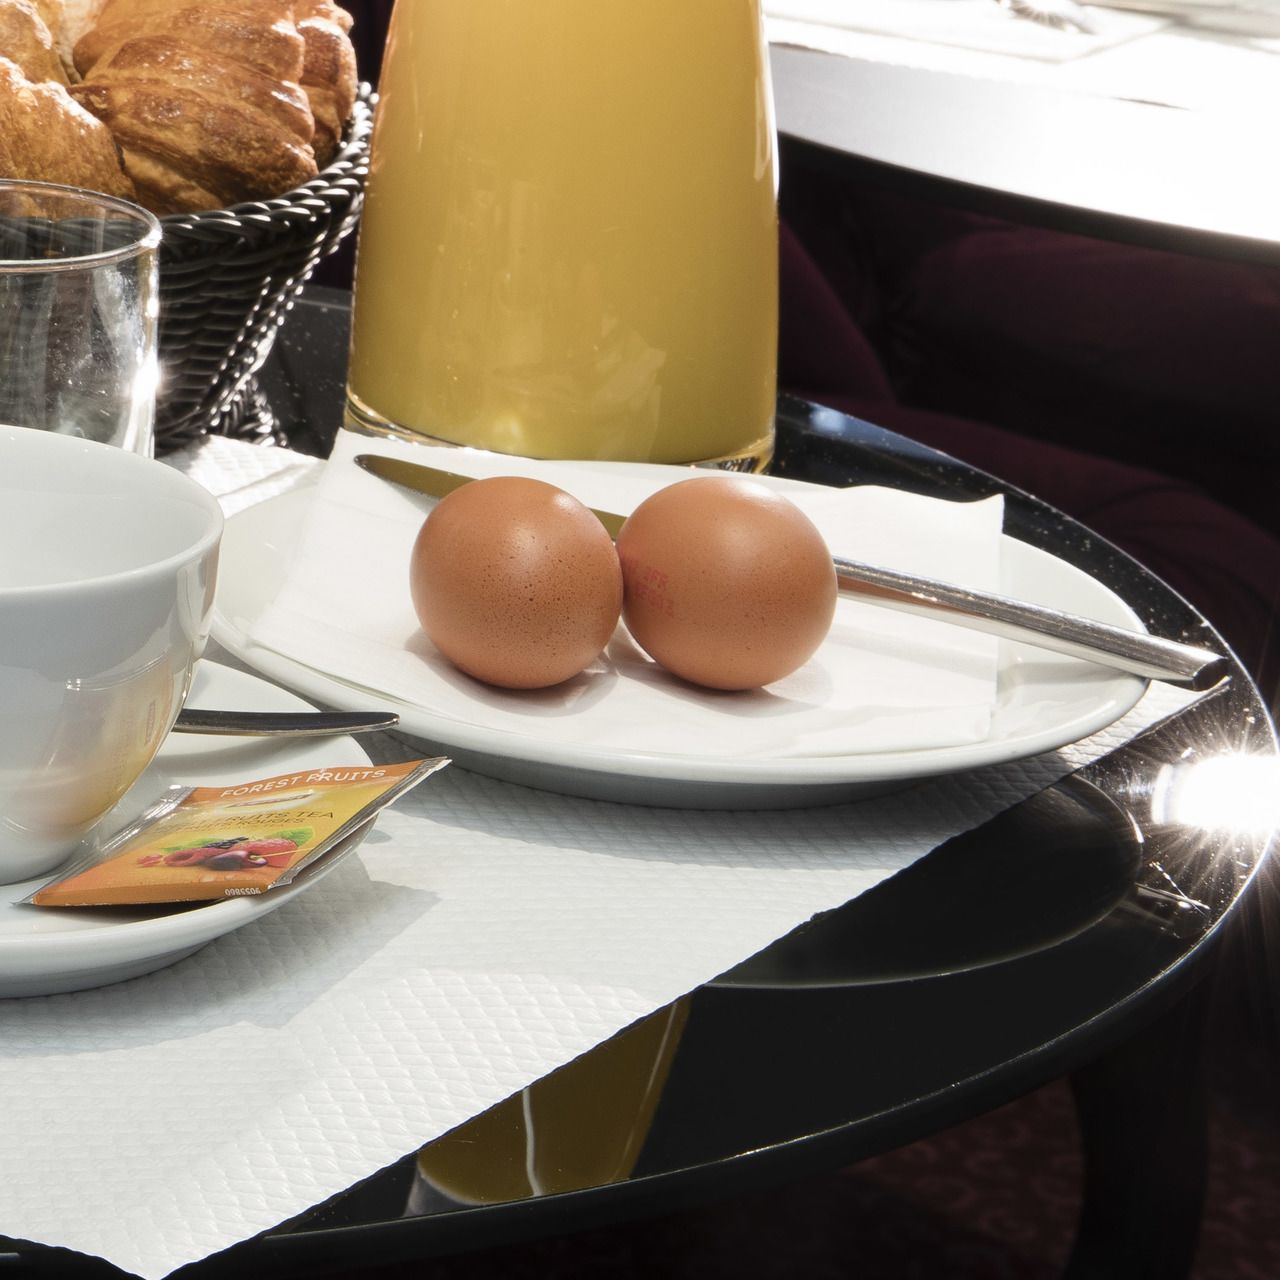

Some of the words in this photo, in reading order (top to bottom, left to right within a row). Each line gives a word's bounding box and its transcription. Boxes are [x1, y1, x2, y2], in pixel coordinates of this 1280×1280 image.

[220, 776, 302, 798] FOREST
[305, 769, 387, 784] FRUITS
[296, 811, 334, 819] TEA
